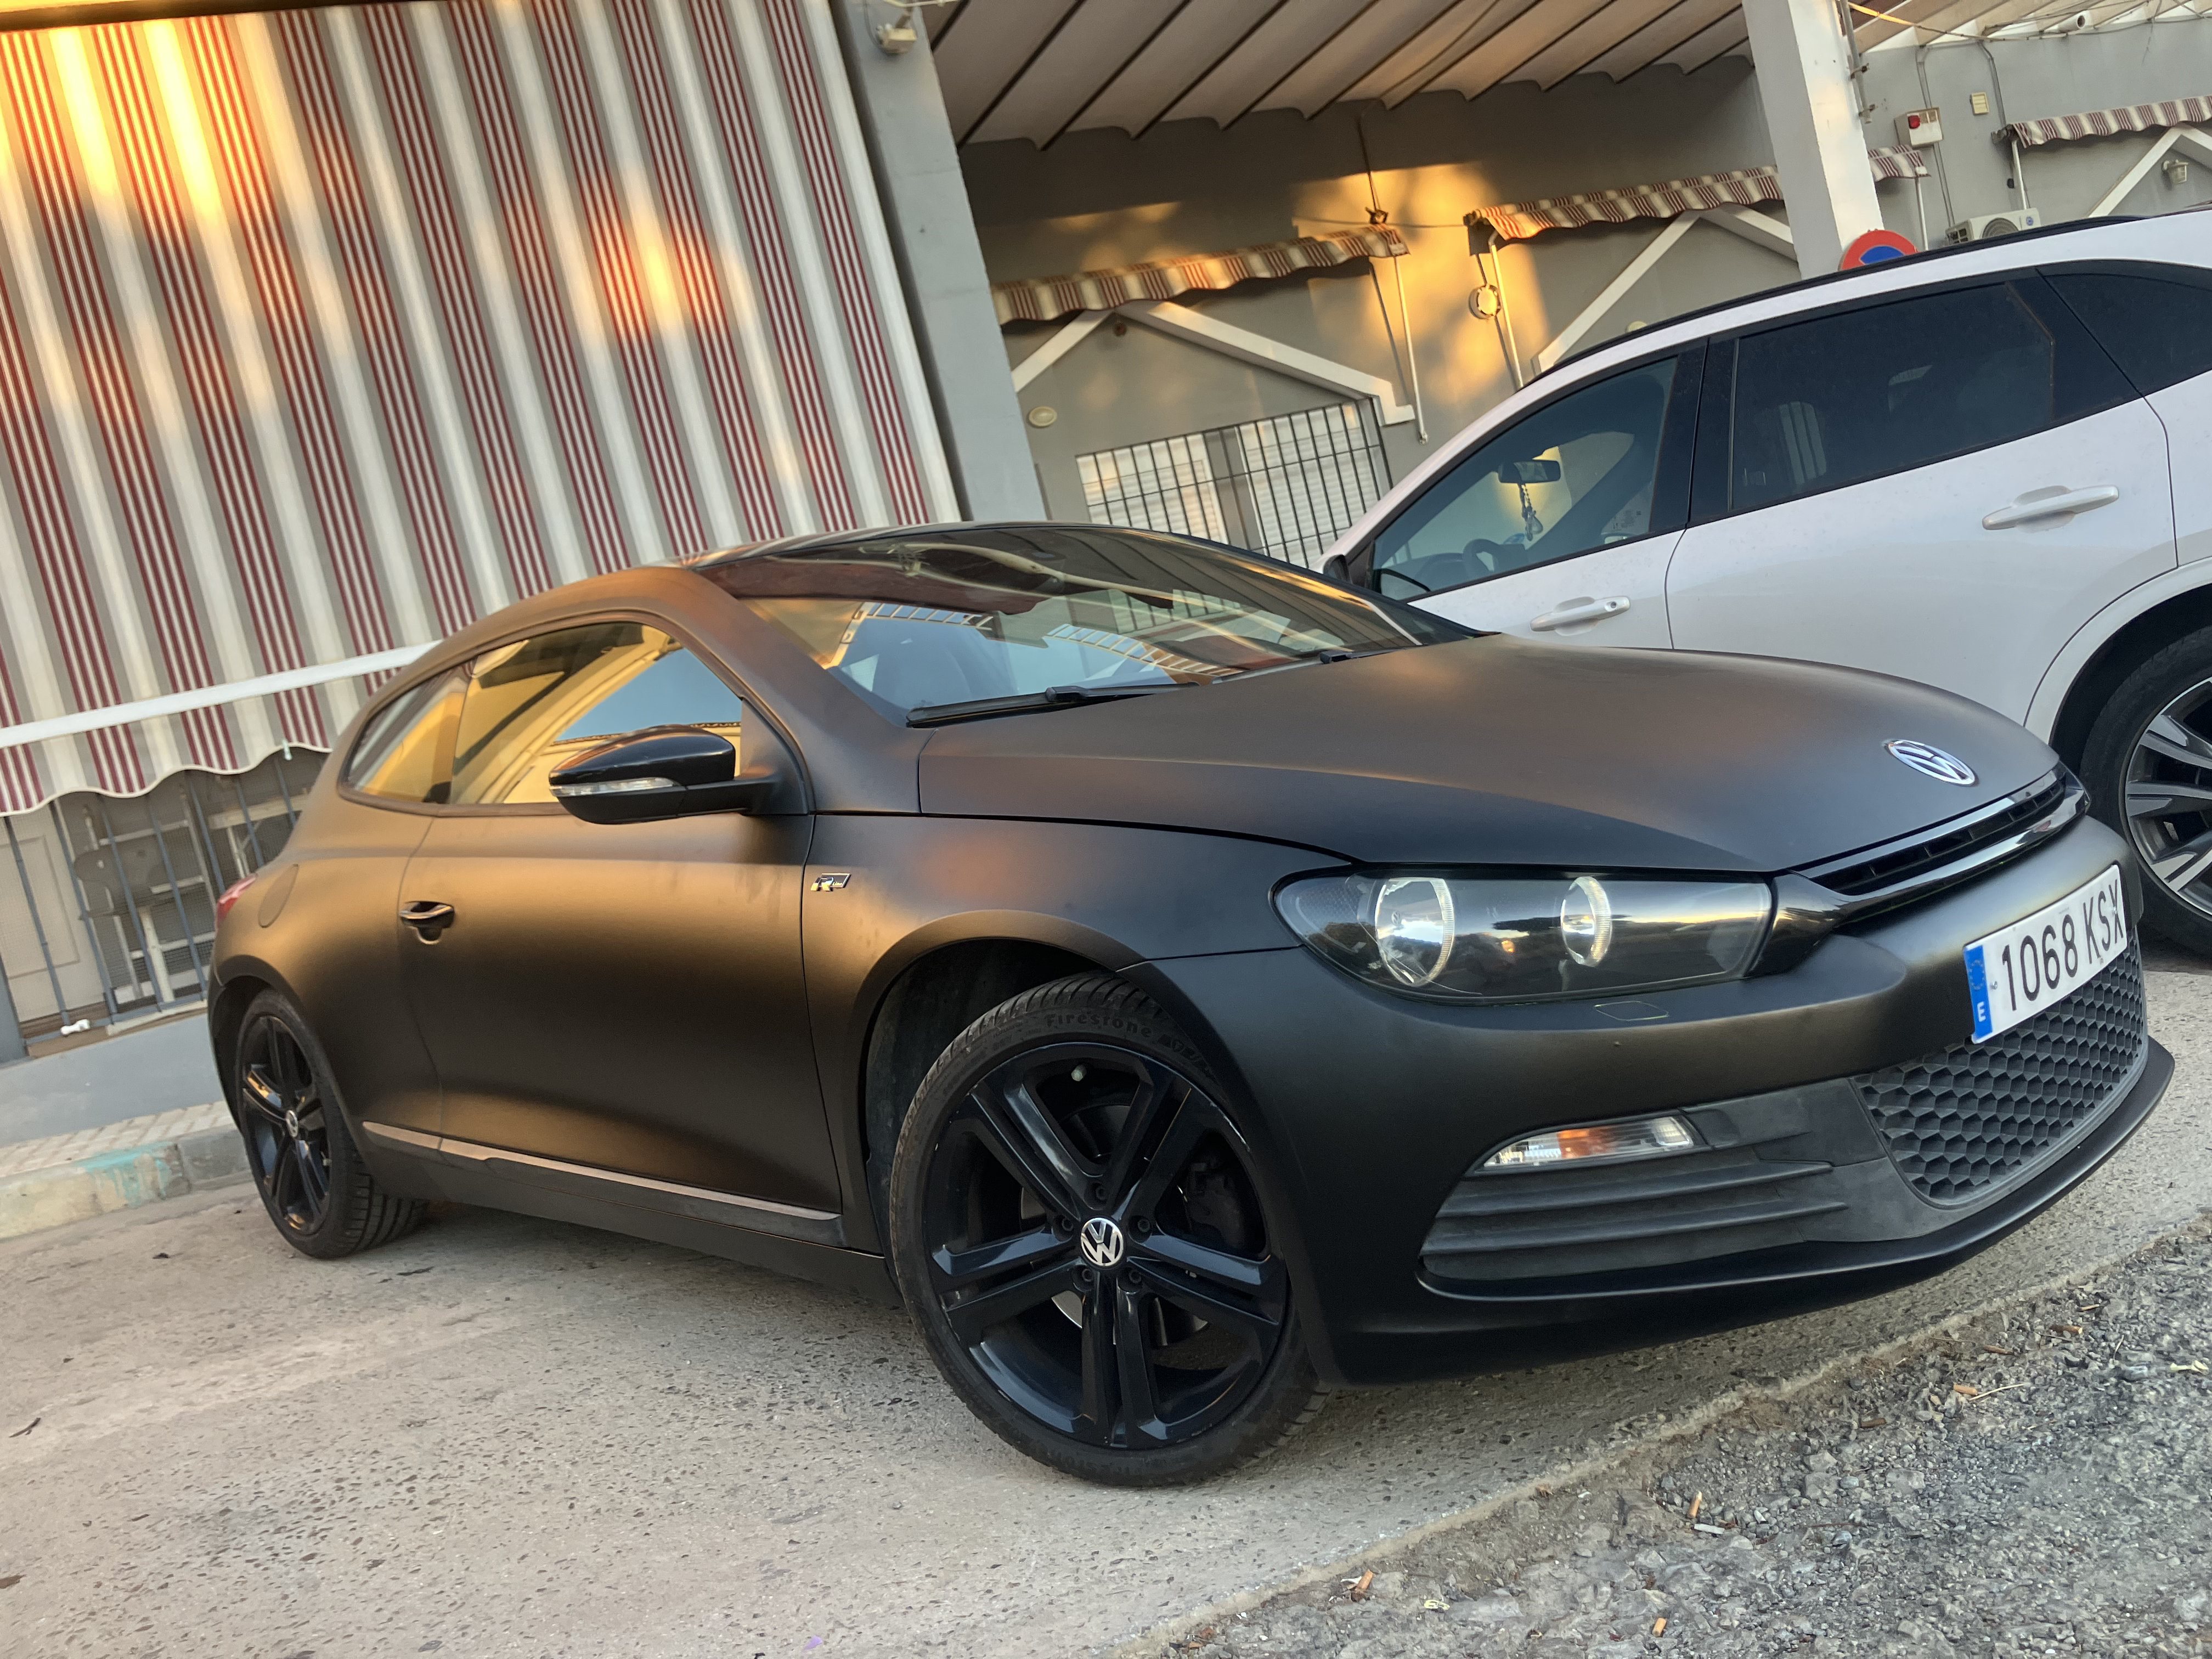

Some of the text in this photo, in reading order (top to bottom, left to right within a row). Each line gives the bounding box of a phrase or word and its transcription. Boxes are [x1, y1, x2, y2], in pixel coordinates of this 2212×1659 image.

[2002, 879, 2124, 1011] 1068 KSX
[1977, 1001, 1986, 1022] E
[1045, 1012, 1152, 1038] Firestone
